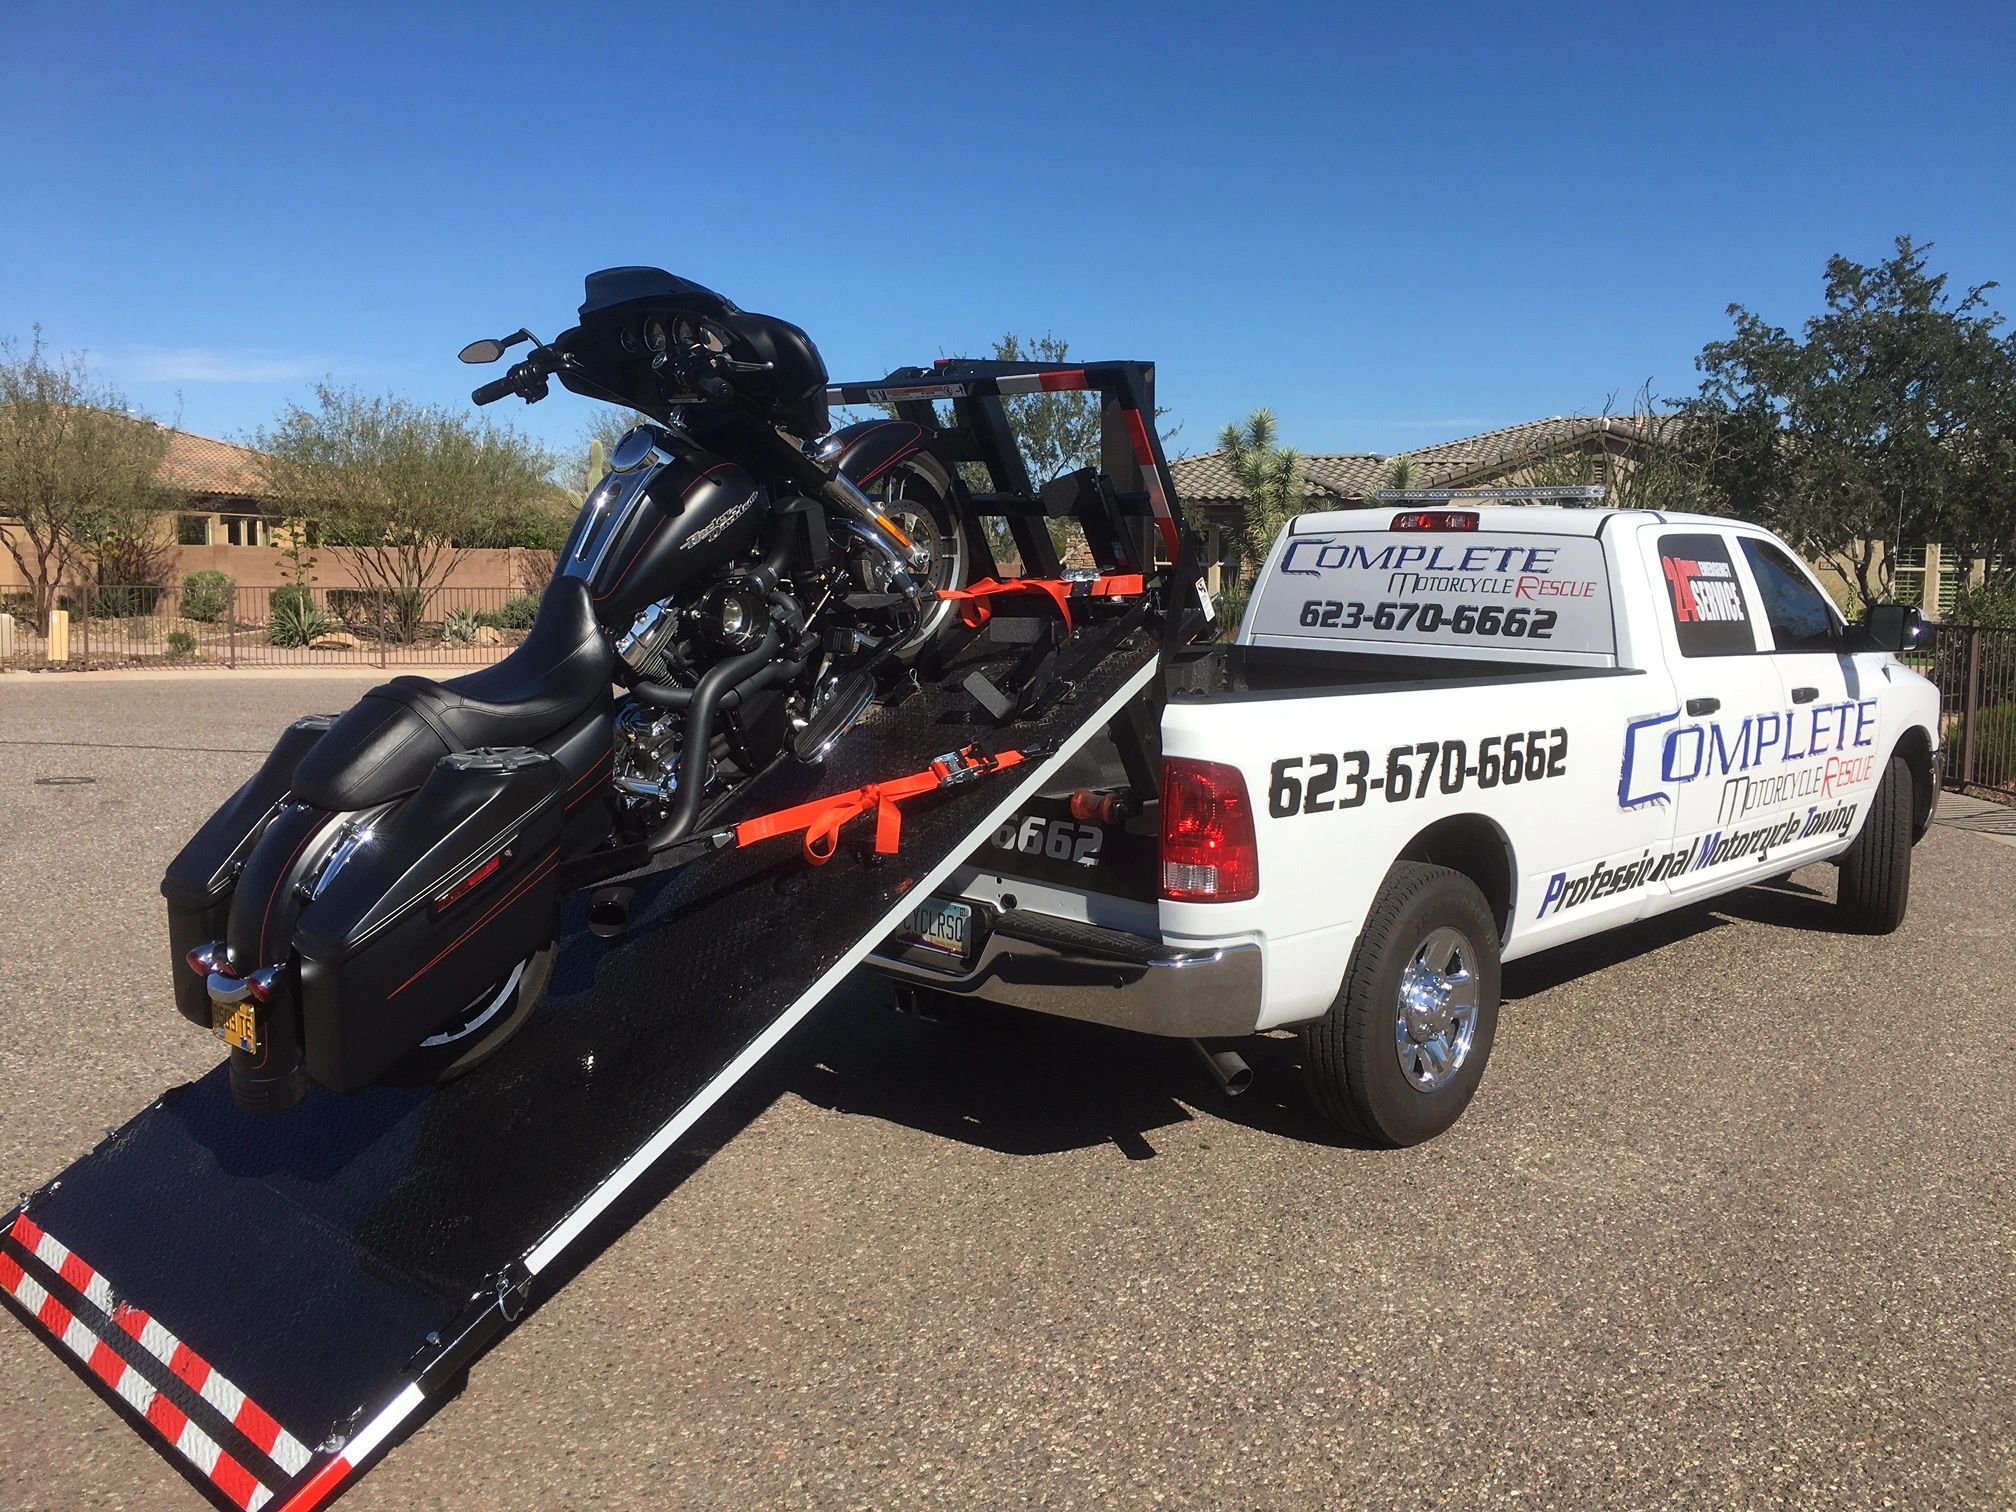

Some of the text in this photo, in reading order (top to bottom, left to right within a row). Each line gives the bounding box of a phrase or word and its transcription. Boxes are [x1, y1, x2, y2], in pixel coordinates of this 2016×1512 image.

[1281, 538, 1560, 577] COMPLETE
[1388, 573, 1597, 601] MOTORCYCLE RESCUE
[1690, 580, 1745, 621] SERVICE
[1300, 601, 1558, 639] 623-670-6662
[1268, 726, 1568, 819] 623-670-6662
[1617, 701, 1877, 813] COMPLETE
[1717, 756, 1874, 824] MOTORCYCLE RESCUE
[991, 814, 1103, 866] 6662
[1536, 800, 1857, 919] Professional Motorcycle Towing
